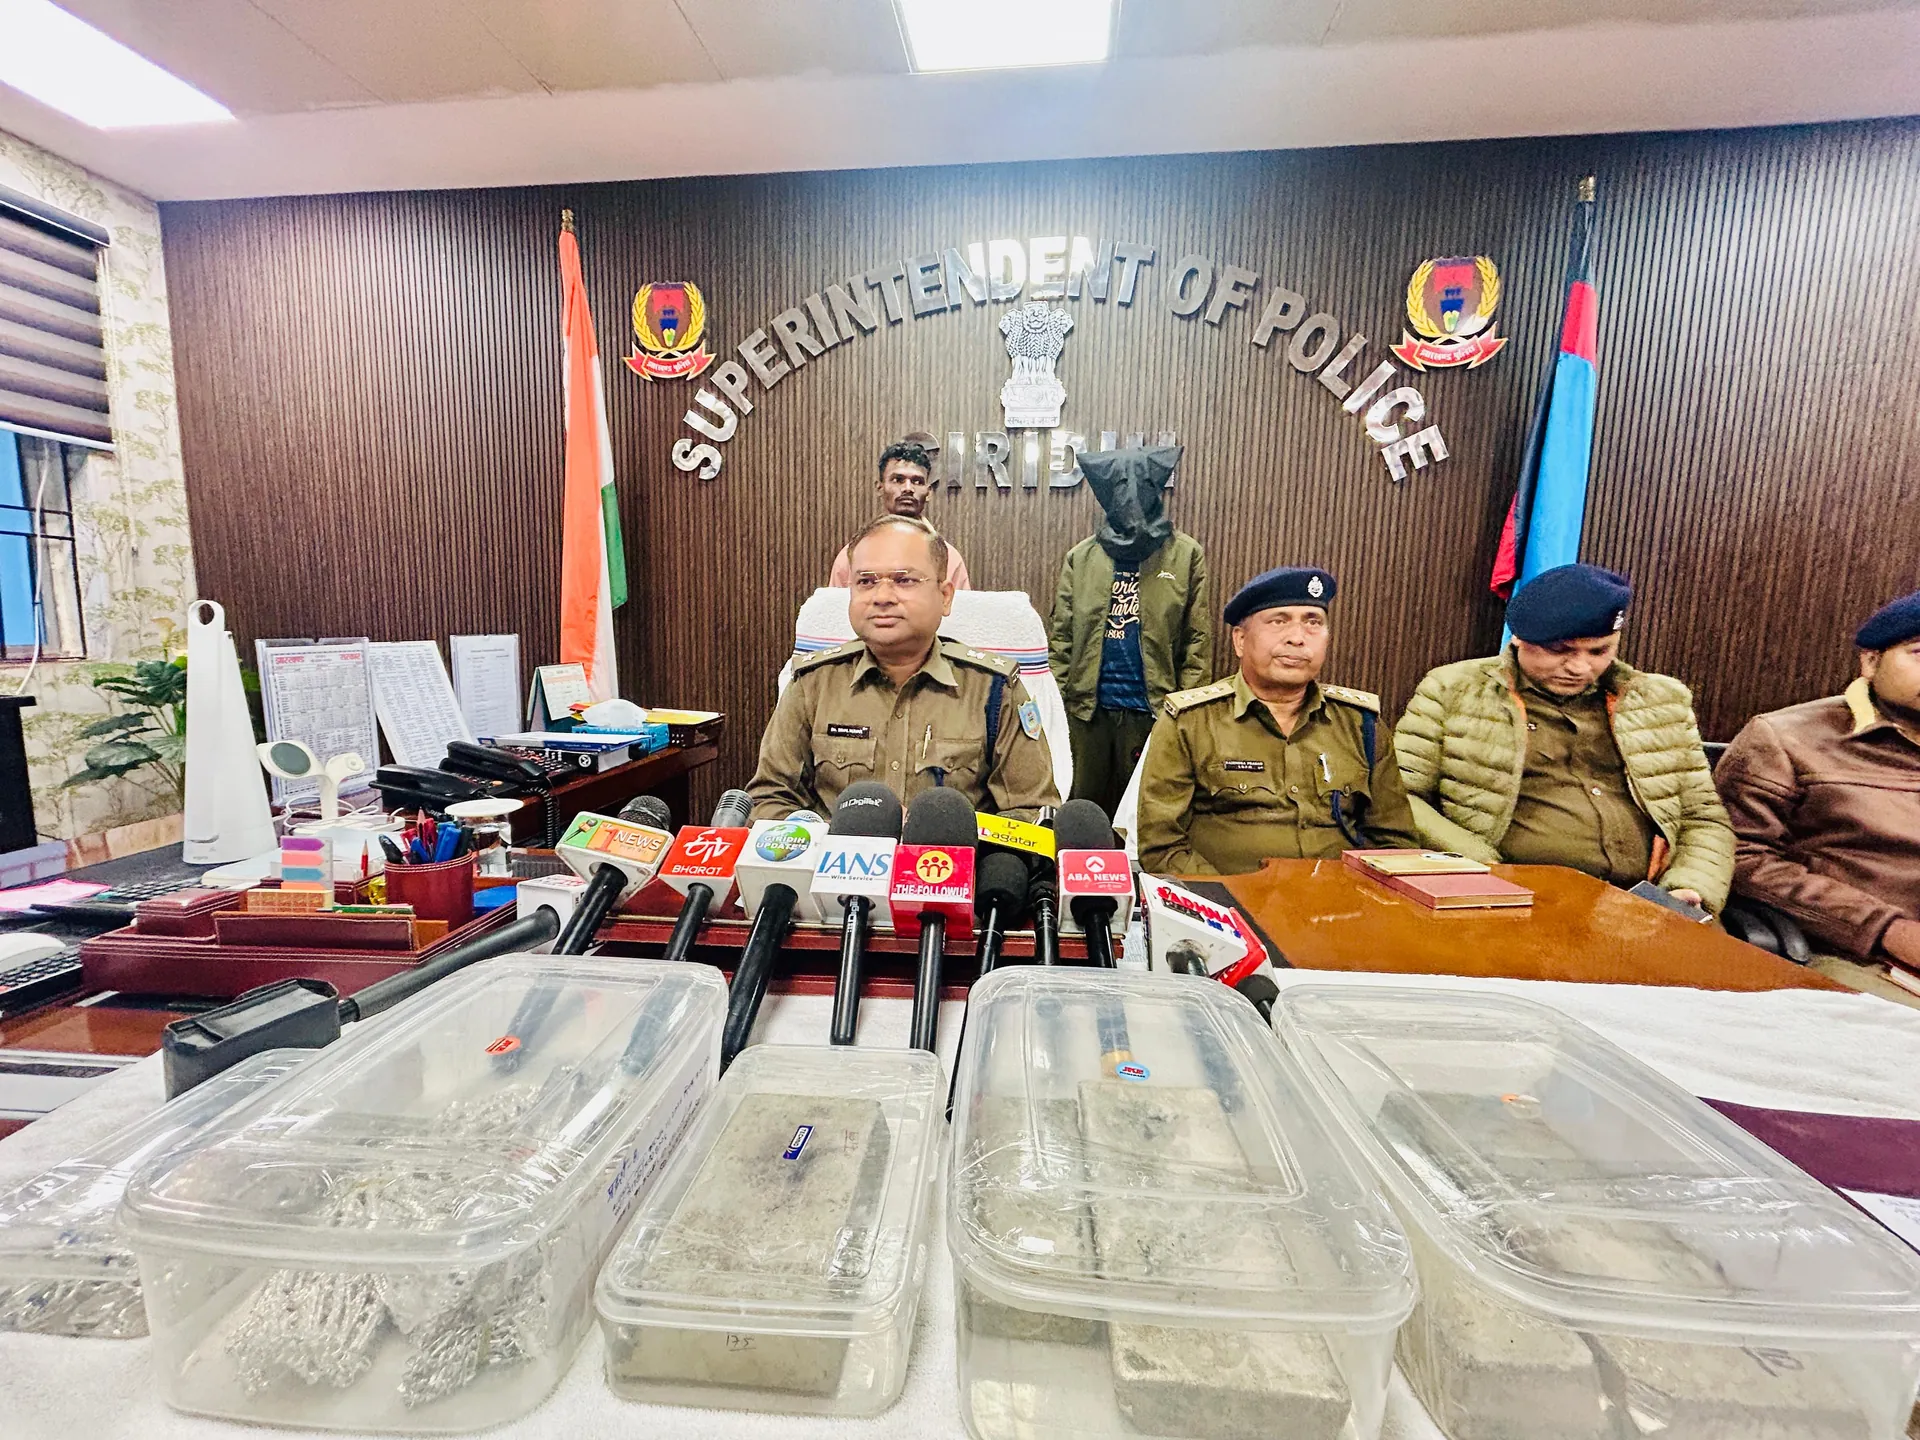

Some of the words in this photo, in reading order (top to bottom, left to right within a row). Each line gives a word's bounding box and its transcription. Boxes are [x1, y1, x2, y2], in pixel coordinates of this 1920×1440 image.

[671, 235, 1155, 480] SUPERINTENDENT
[1167, 253, 1260, 325] OF
[1251, 286, 1450, 482] POLICE
[614, 830, 662, 852] NEWS
[980, 827, 1038, 848] Lagatar
[671, 864, 723, 876] BHARAT
[816, 850, 893, 877] IANS
[1066, 873, 1090, 882] ABA
[1093, 873, 1128, 882] NEWS
[894, 883, 915, 896] THE
[917, 884, 970, 899] FOLLOWUP
